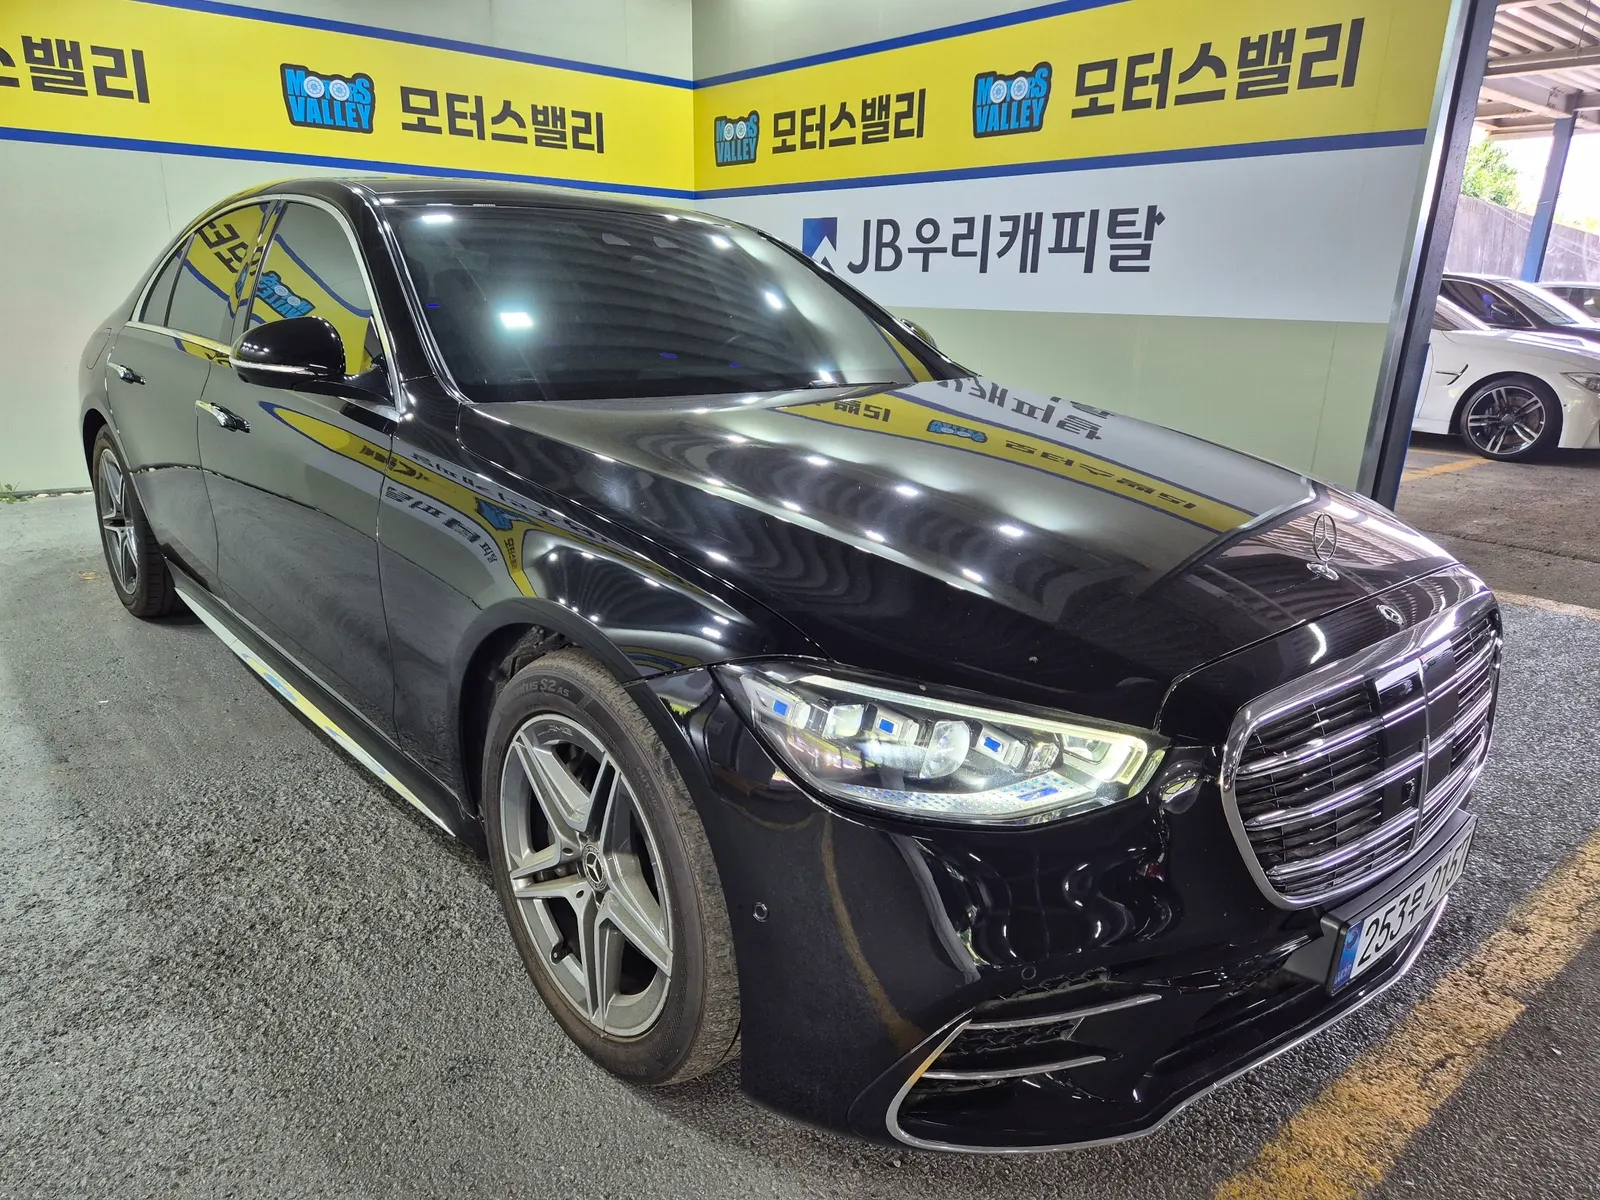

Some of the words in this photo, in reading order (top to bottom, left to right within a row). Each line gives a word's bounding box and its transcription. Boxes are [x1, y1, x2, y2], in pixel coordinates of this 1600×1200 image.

[1070, 17, 1366, 119] 모터스밸리
[288, 95, 371, 130] VALLEY
[399, 85, 605, 154] 모터스밸리
[771, 88, 927, 155] 모터스밸리
[976, 97, 1045, 134] VALLEY
[716, 137, 757, 163] VALLEY
[846, 204, 1166, 275] JB우리캐피탈
[540, 678, 557, 692] S2
[557, 687, 570, 697] AS
[1356, 881, 1427, 968] 253무
[1423, 832, 1472, 911] 2157
